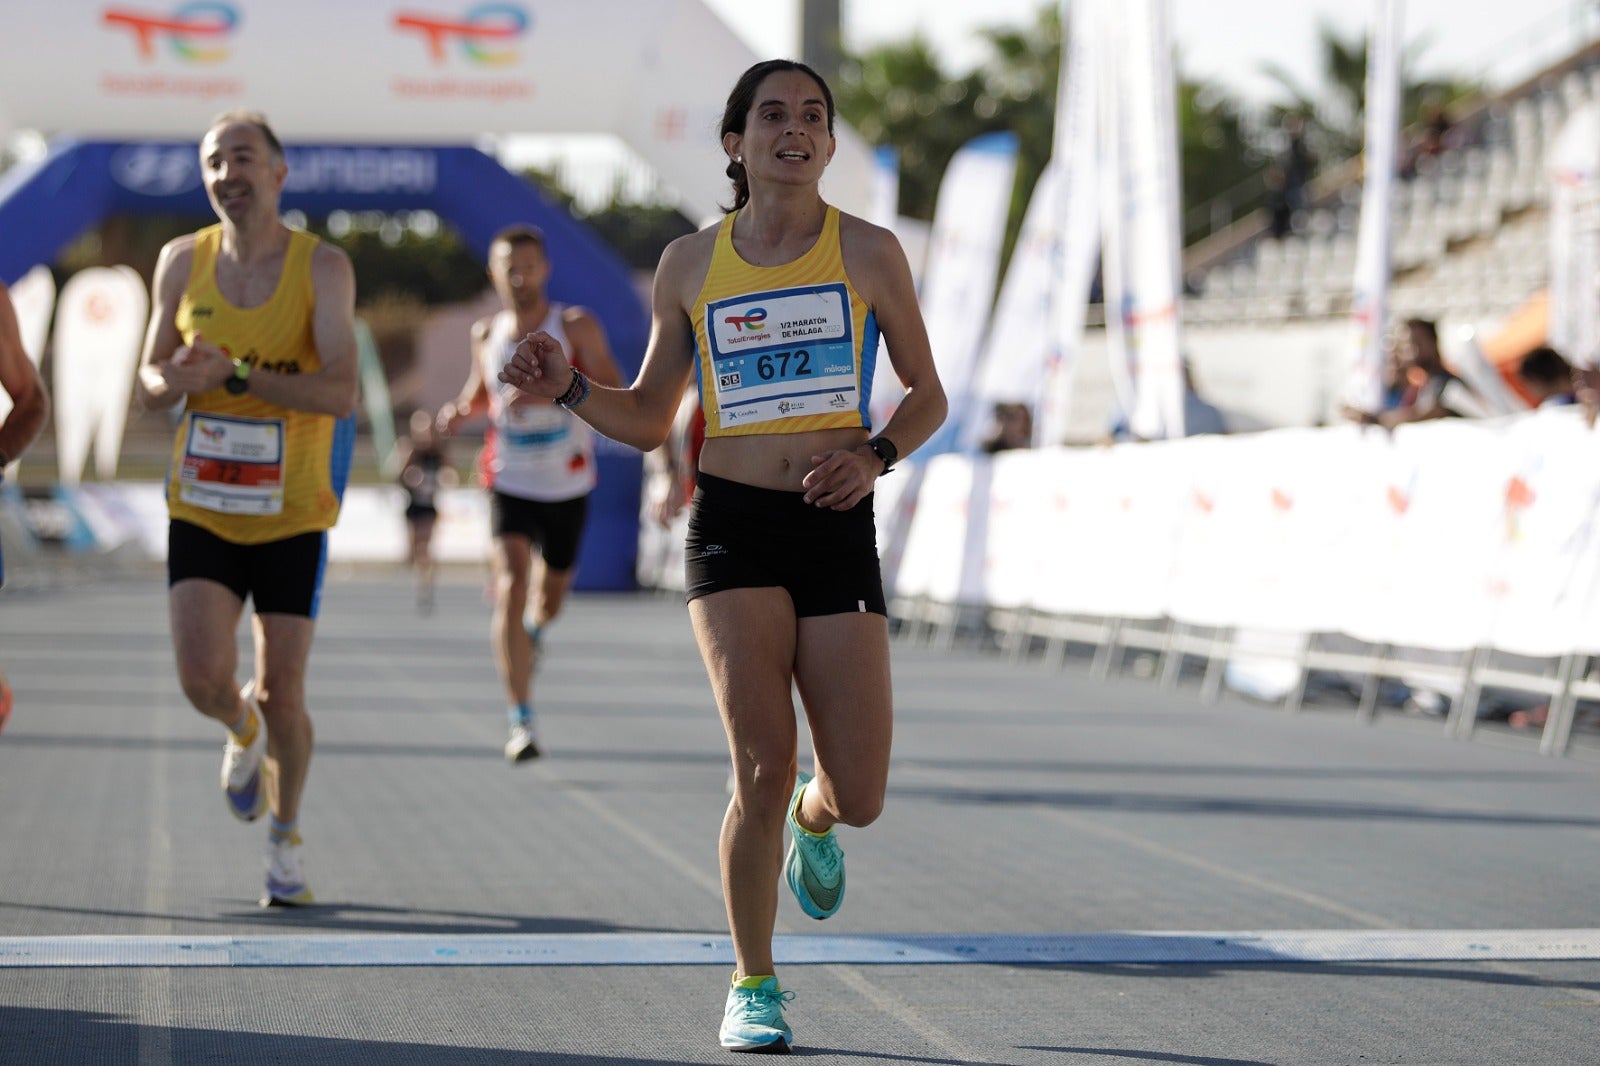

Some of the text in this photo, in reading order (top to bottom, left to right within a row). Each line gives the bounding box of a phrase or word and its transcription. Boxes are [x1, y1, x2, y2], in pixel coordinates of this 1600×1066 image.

[780, 316, 827, 329] 1/2 MARATÓN
[792, 327, 823, 336] MÁLAGA
[727, 333, 772, 344] TotalEnergies
[757, 350, 812, 381] 672
[824, 364, 852, 374] málaga
